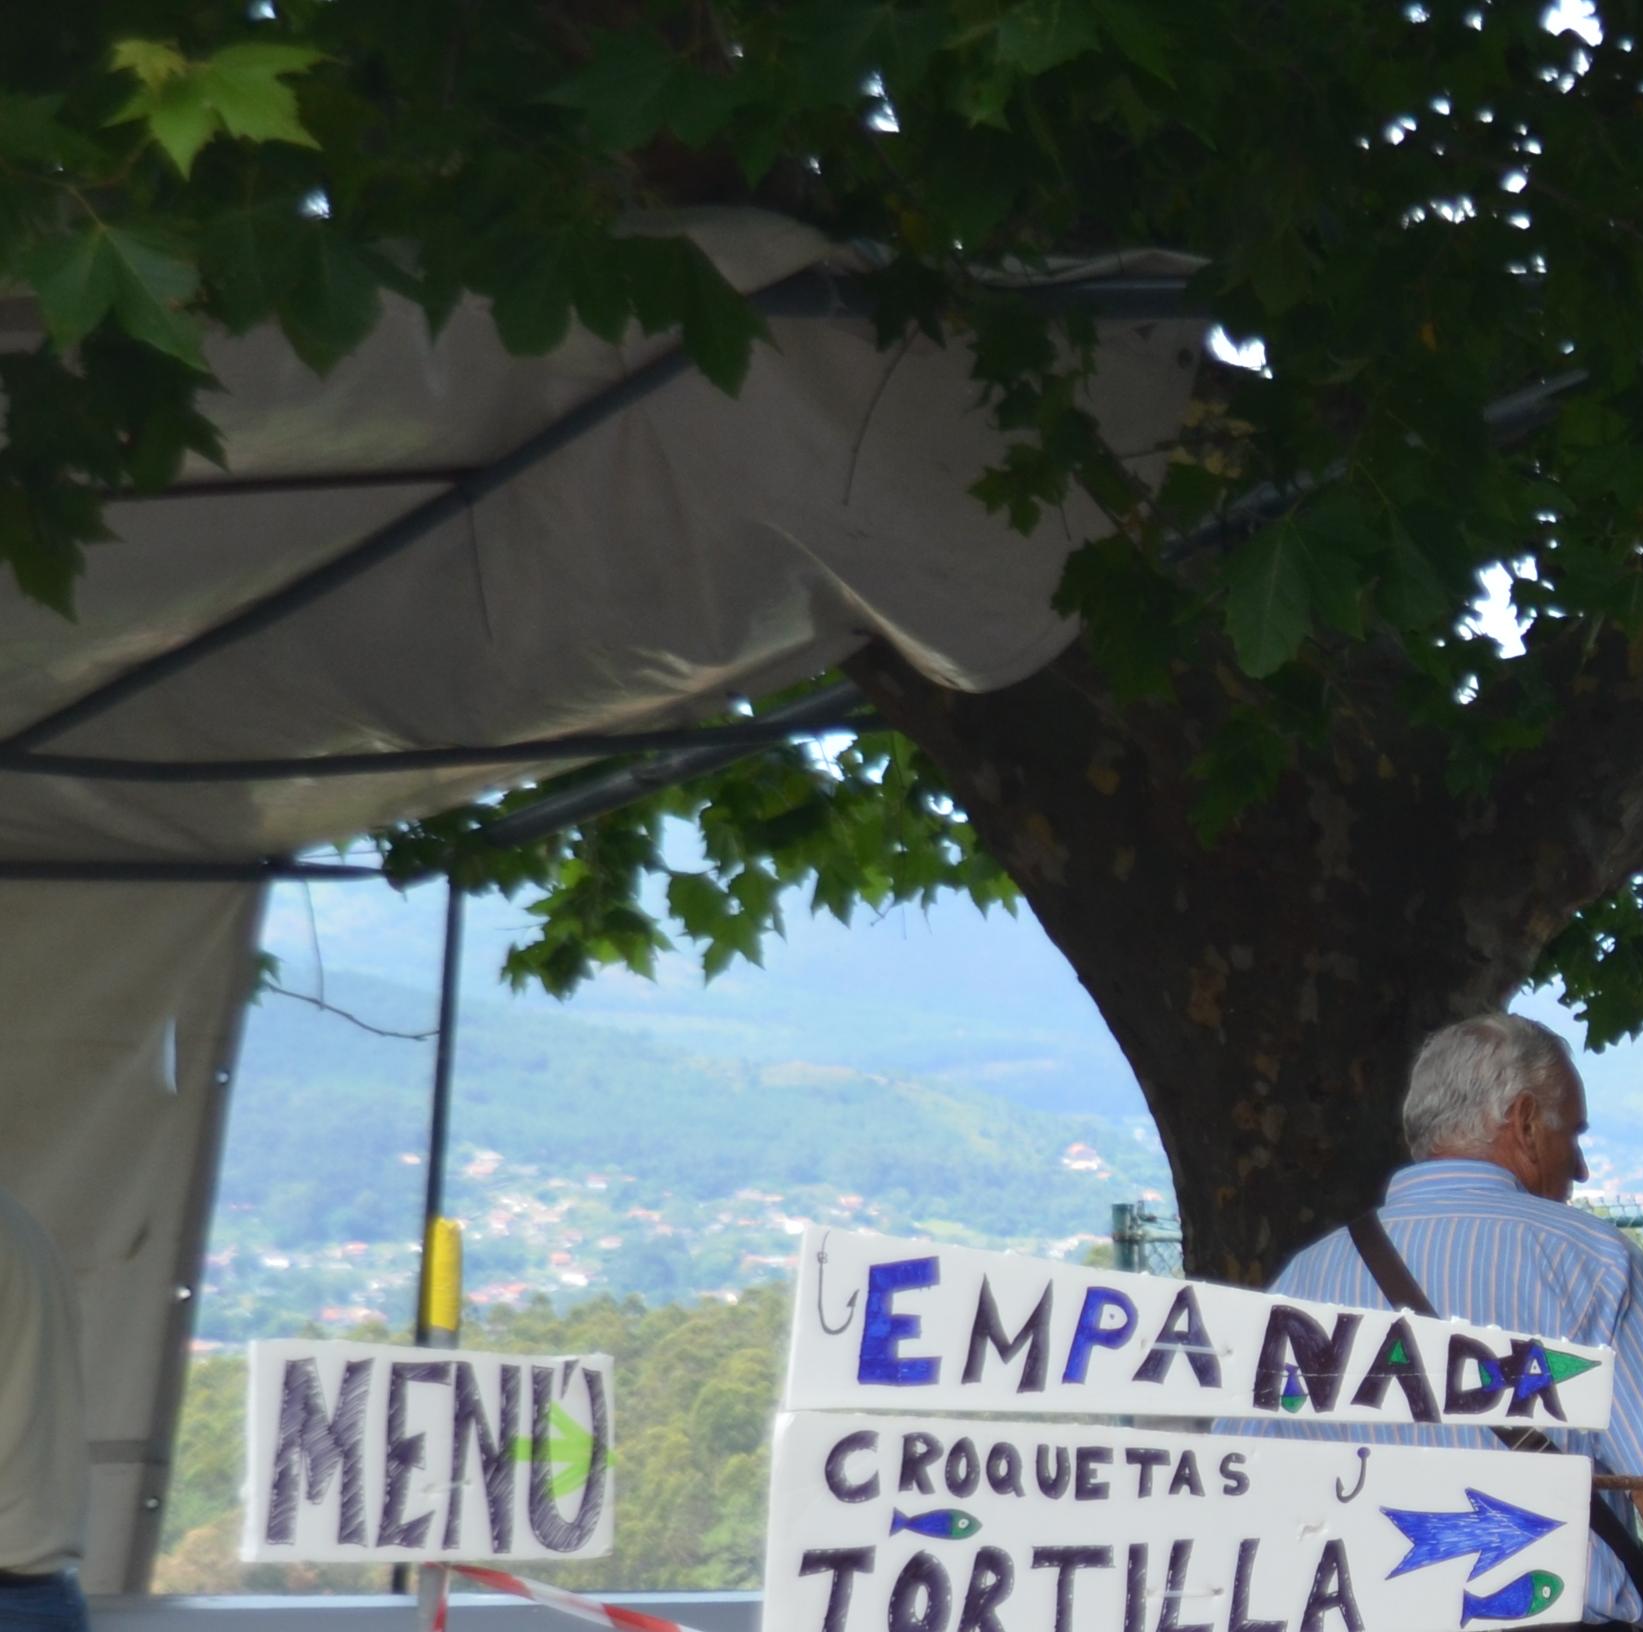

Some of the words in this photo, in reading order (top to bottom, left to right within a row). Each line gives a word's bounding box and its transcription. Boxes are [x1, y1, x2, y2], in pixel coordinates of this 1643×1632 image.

[857, 1255, 1568, 1423] EMPANADA
[265, 1357, 607, 1555] MENÚ
[824, 1429, 1250, 1504] CROQUETAS
